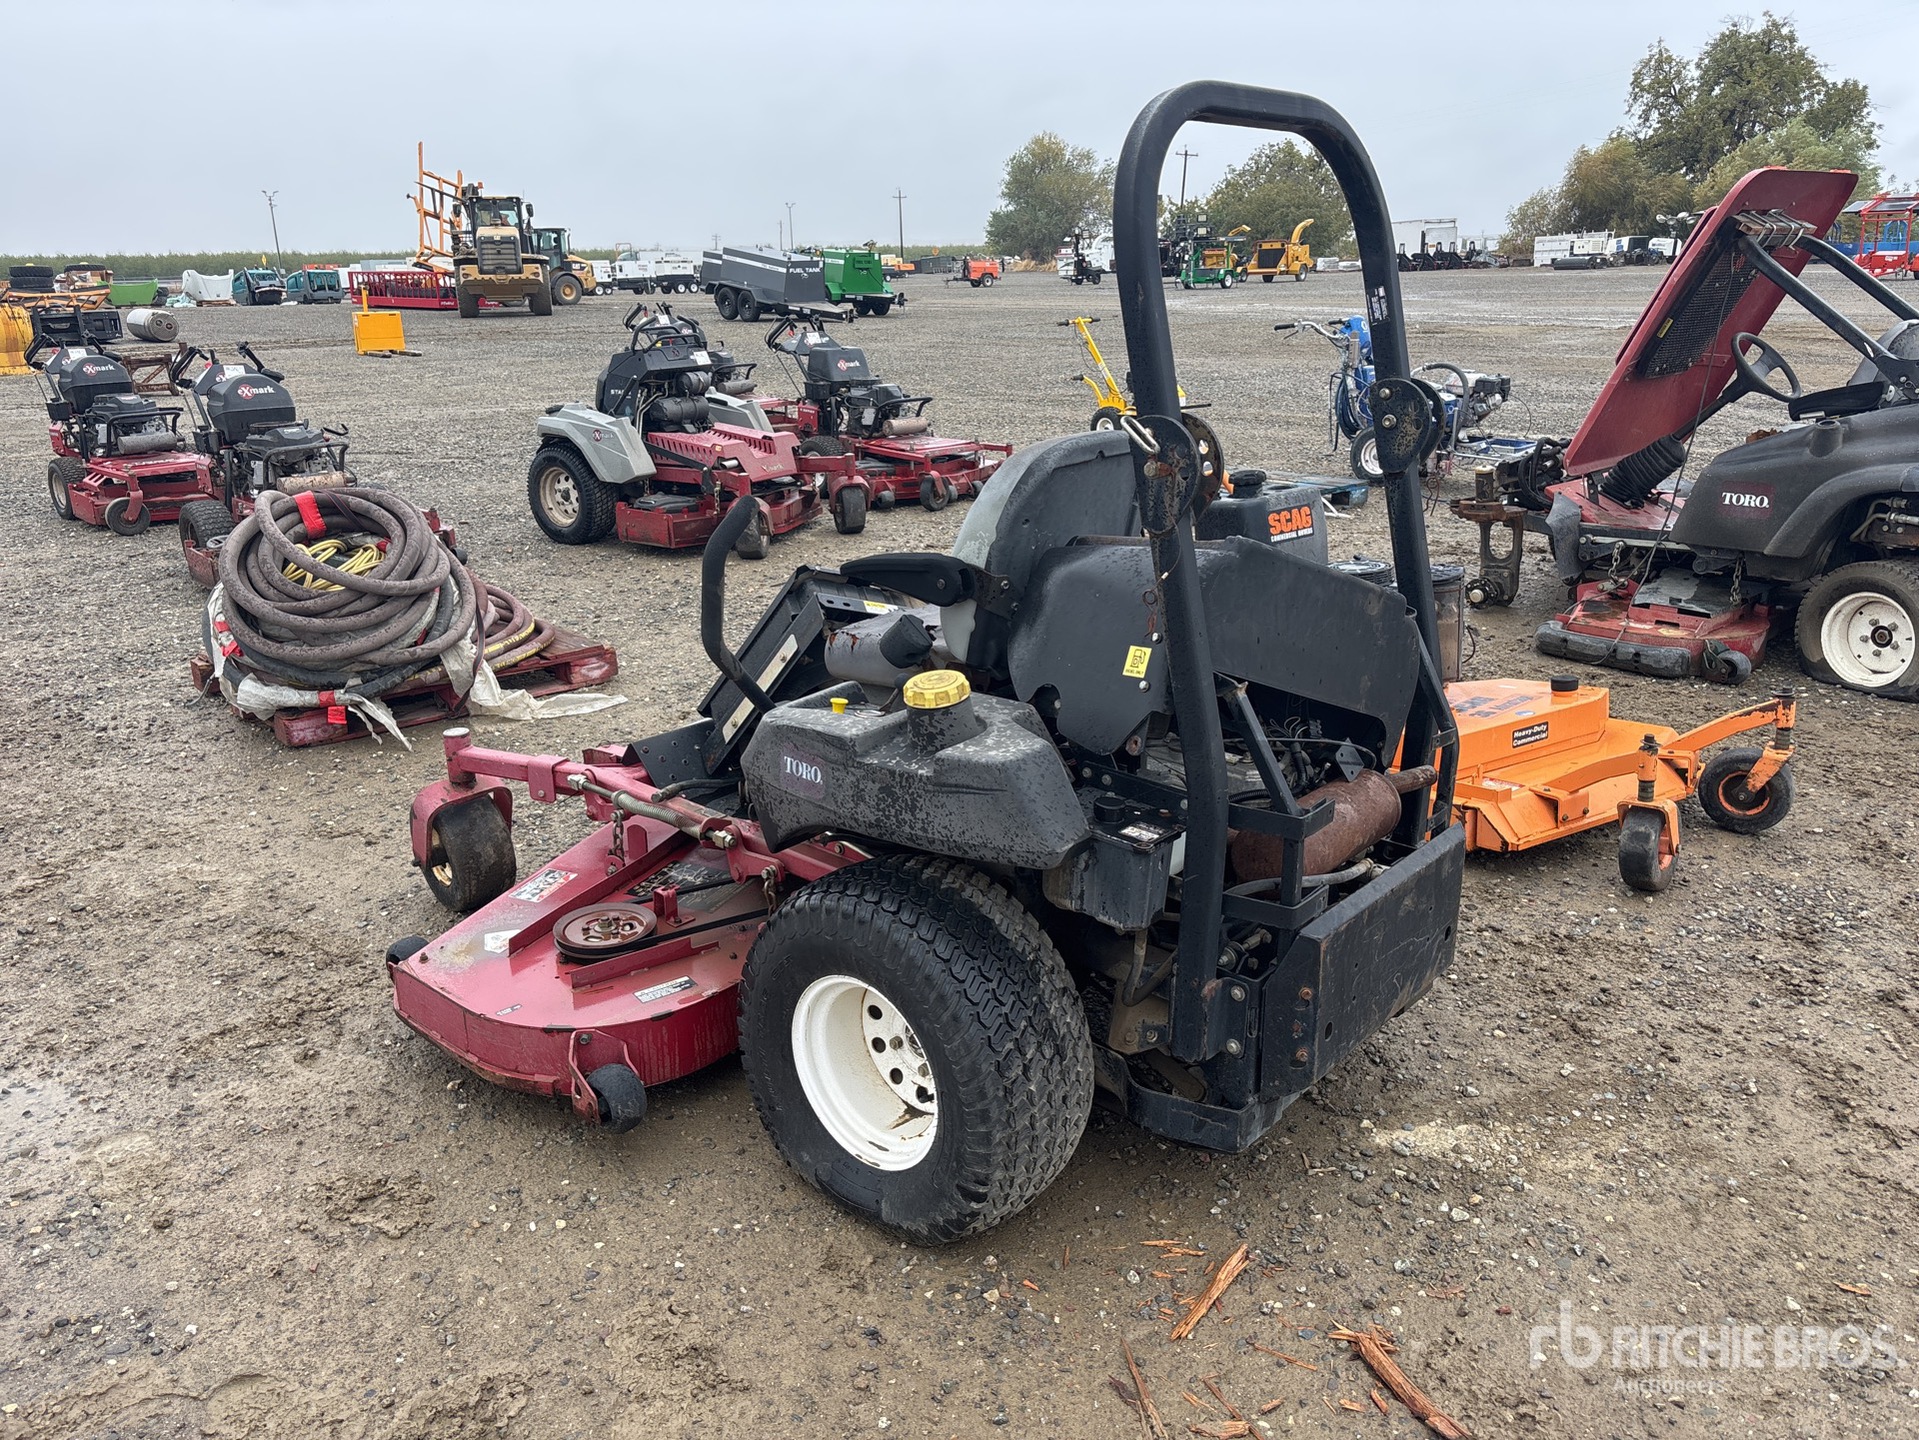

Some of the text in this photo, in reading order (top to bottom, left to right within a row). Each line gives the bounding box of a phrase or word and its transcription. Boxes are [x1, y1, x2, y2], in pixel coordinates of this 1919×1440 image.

[1268, 506, 1313, 535] SCAG
[1513, 724, 1548, 739] Heavy-Duty
[1513, 731, 1548, 746] Commercial
